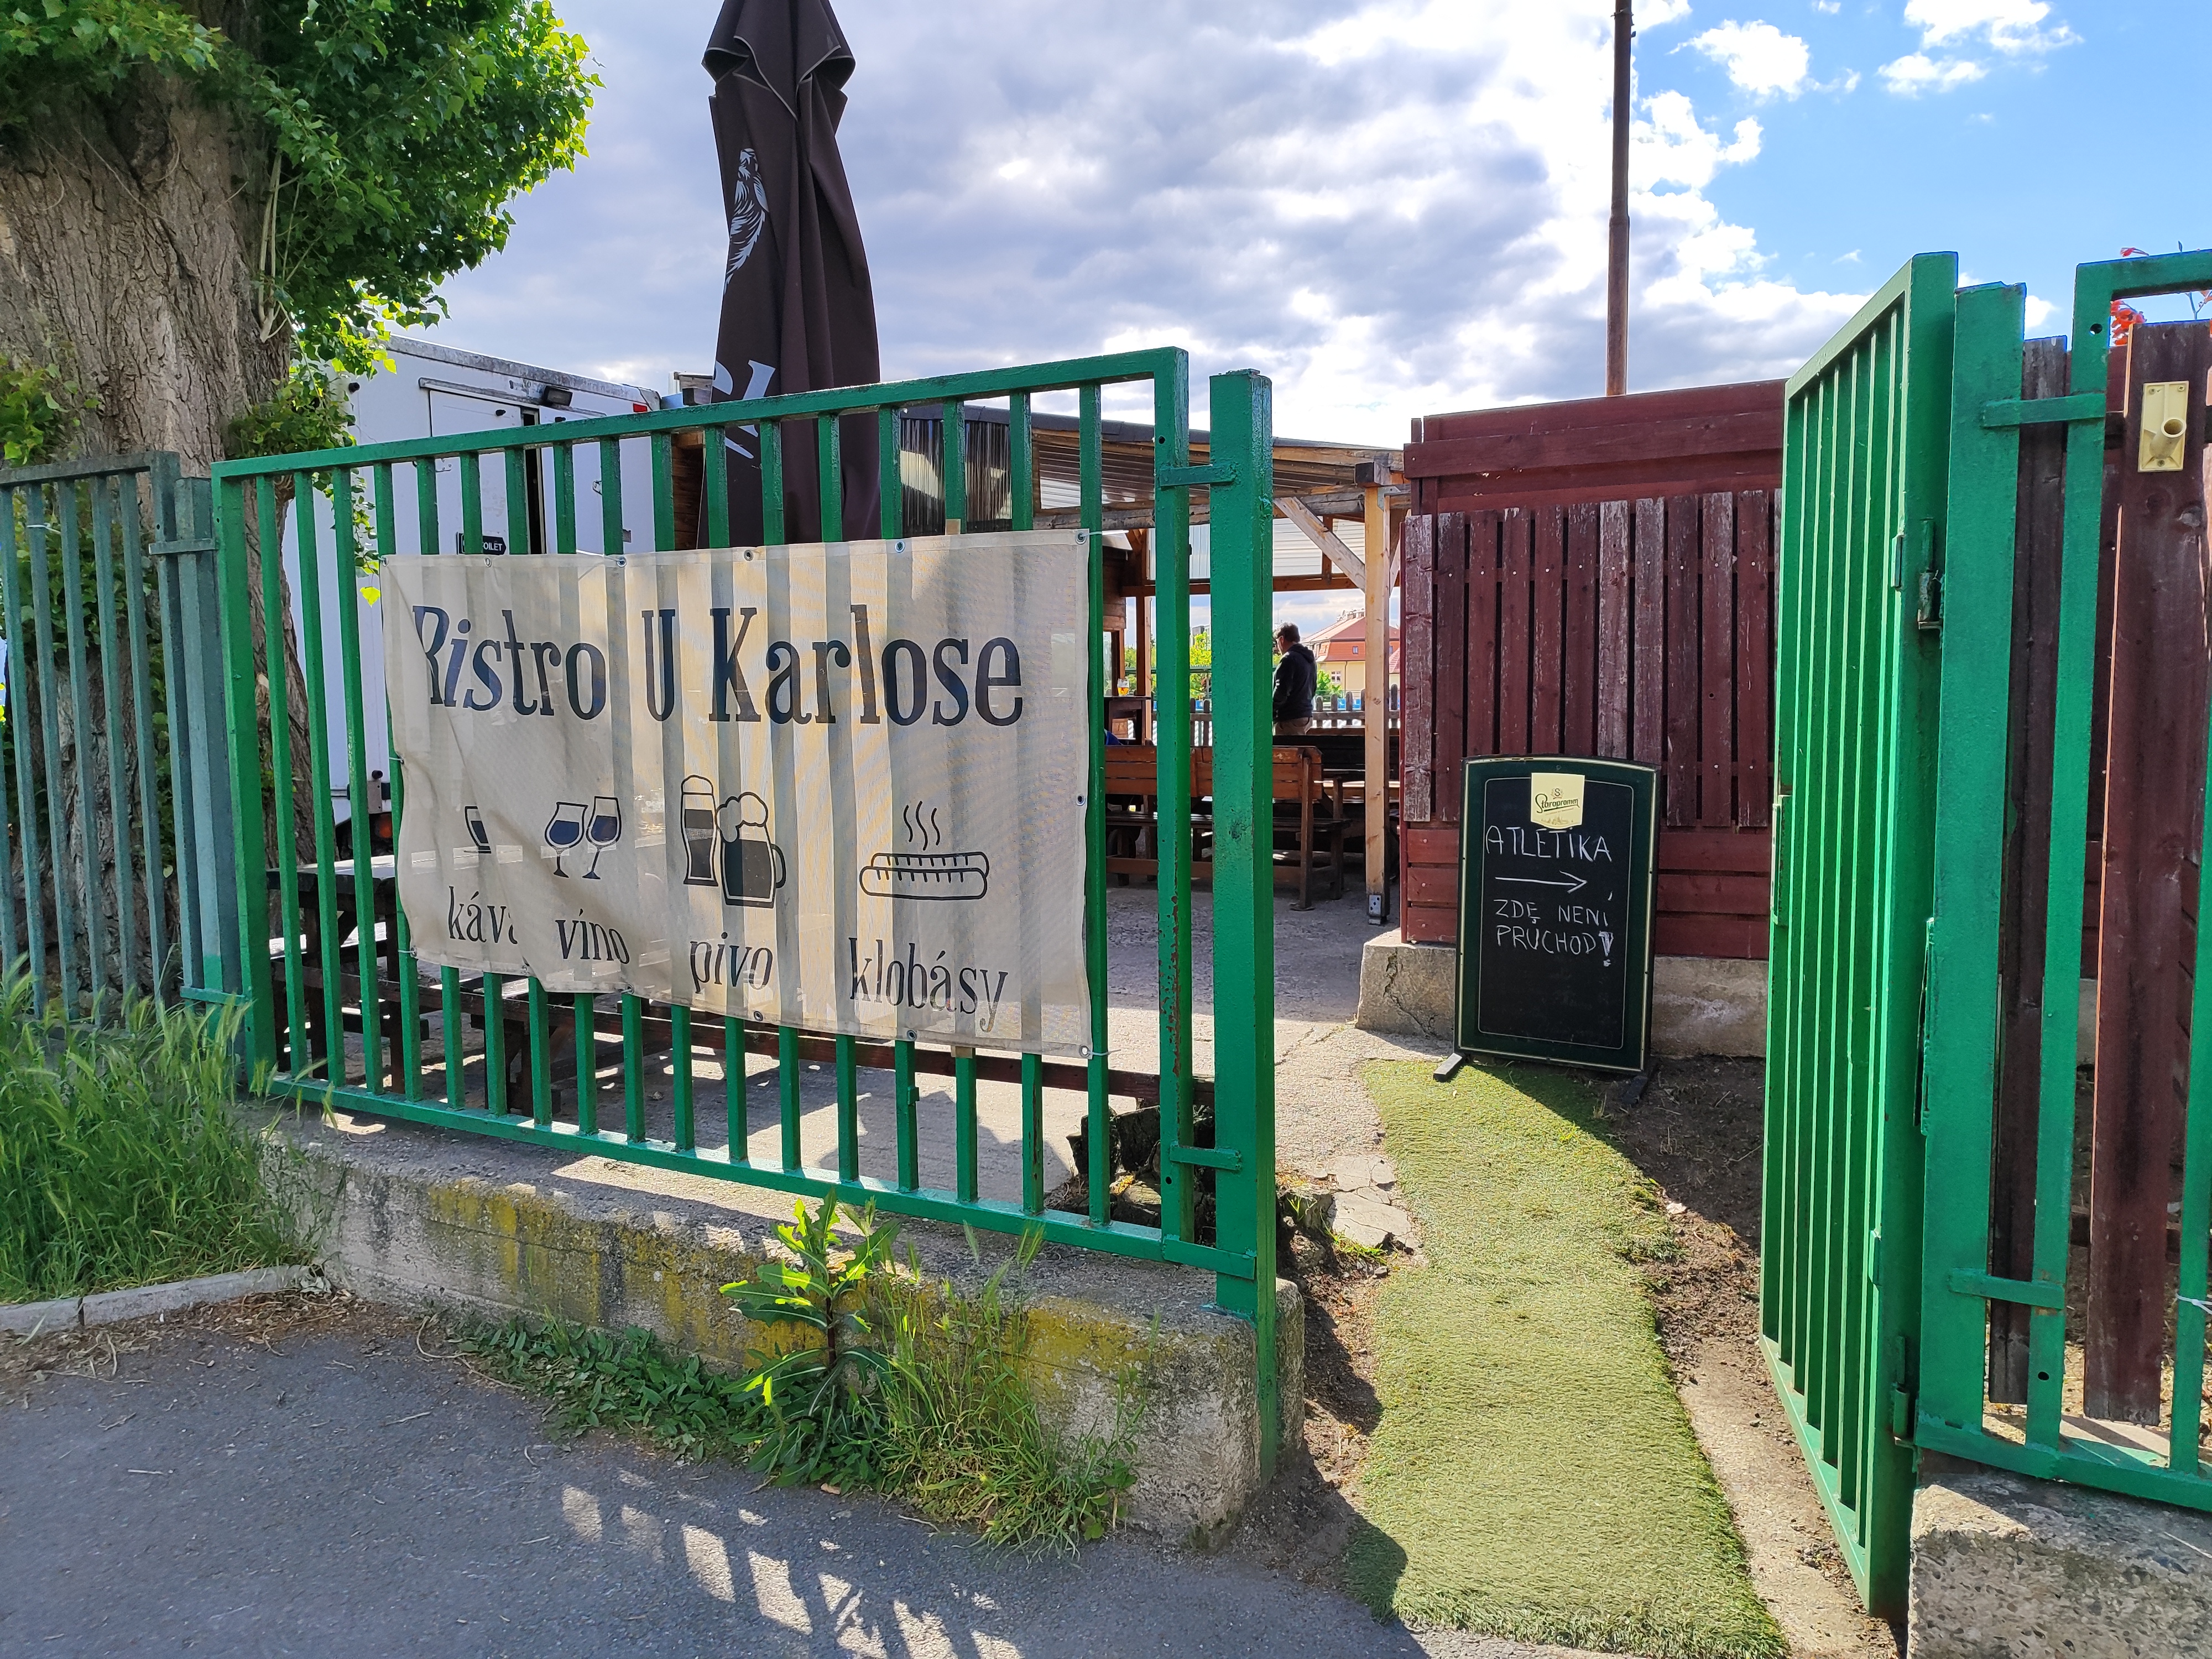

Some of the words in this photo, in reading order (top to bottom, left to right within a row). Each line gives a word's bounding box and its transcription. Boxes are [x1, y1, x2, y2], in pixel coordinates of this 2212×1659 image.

[482, 541, 503, 551] OILET
[642, 608, 676, 722] U
[708, 604, 1023, 727] Karlose
[1535, 793, 1580, 813] Staropramen
[1485, 825, 1613, 863] ATLETIKA
[1558, 891, 1614, 927] NENÍ
[555, 907, 630, 964] víno
[690, 932, 774, 994] pivo
[848, 937, 1009, 1033] klobásy
